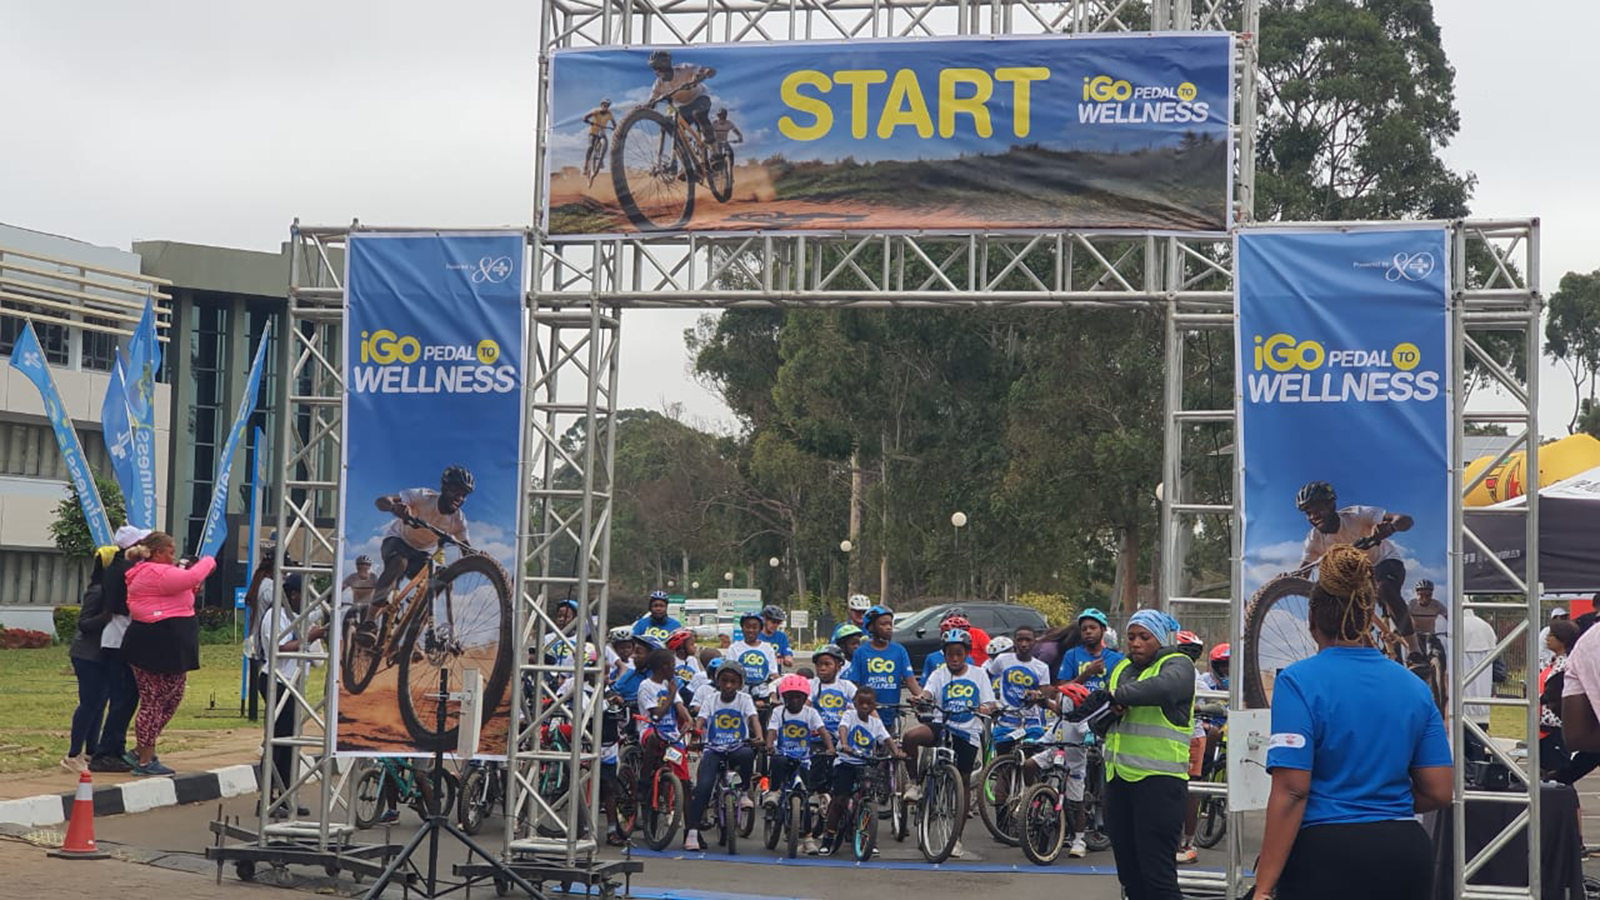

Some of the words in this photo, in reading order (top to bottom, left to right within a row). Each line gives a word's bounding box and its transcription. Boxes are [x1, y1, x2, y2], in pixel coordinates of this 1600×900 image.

[1083, 75, 1132, 102] iGo
[1134, 87, 1178, 100] PEDAL
[778, 66, 1051, 142] START
[1078, 101, 1210, 124] WELLNESS
[361, 329, 421, 365] iGo
[423, 345, 477, 361] PEDAL
[1254, 333, 1325, 372] iGo
[1328, 350, 1392, 368] PEDAL
[354, 365, 516, 393] WELLNESS
[1248, 371, 1440, 403] WELLNESS
[744, 653, 764, 666] iGo
[867, 657, 895, 673] iGo
[1008, 669, 1034, 687] iGo
[819, 693, 843, 708] iGo
[947, 684, 974, 699] iGo
[714, 714, 741, 730] iGo
[782, 724, 808, 739] iGo
